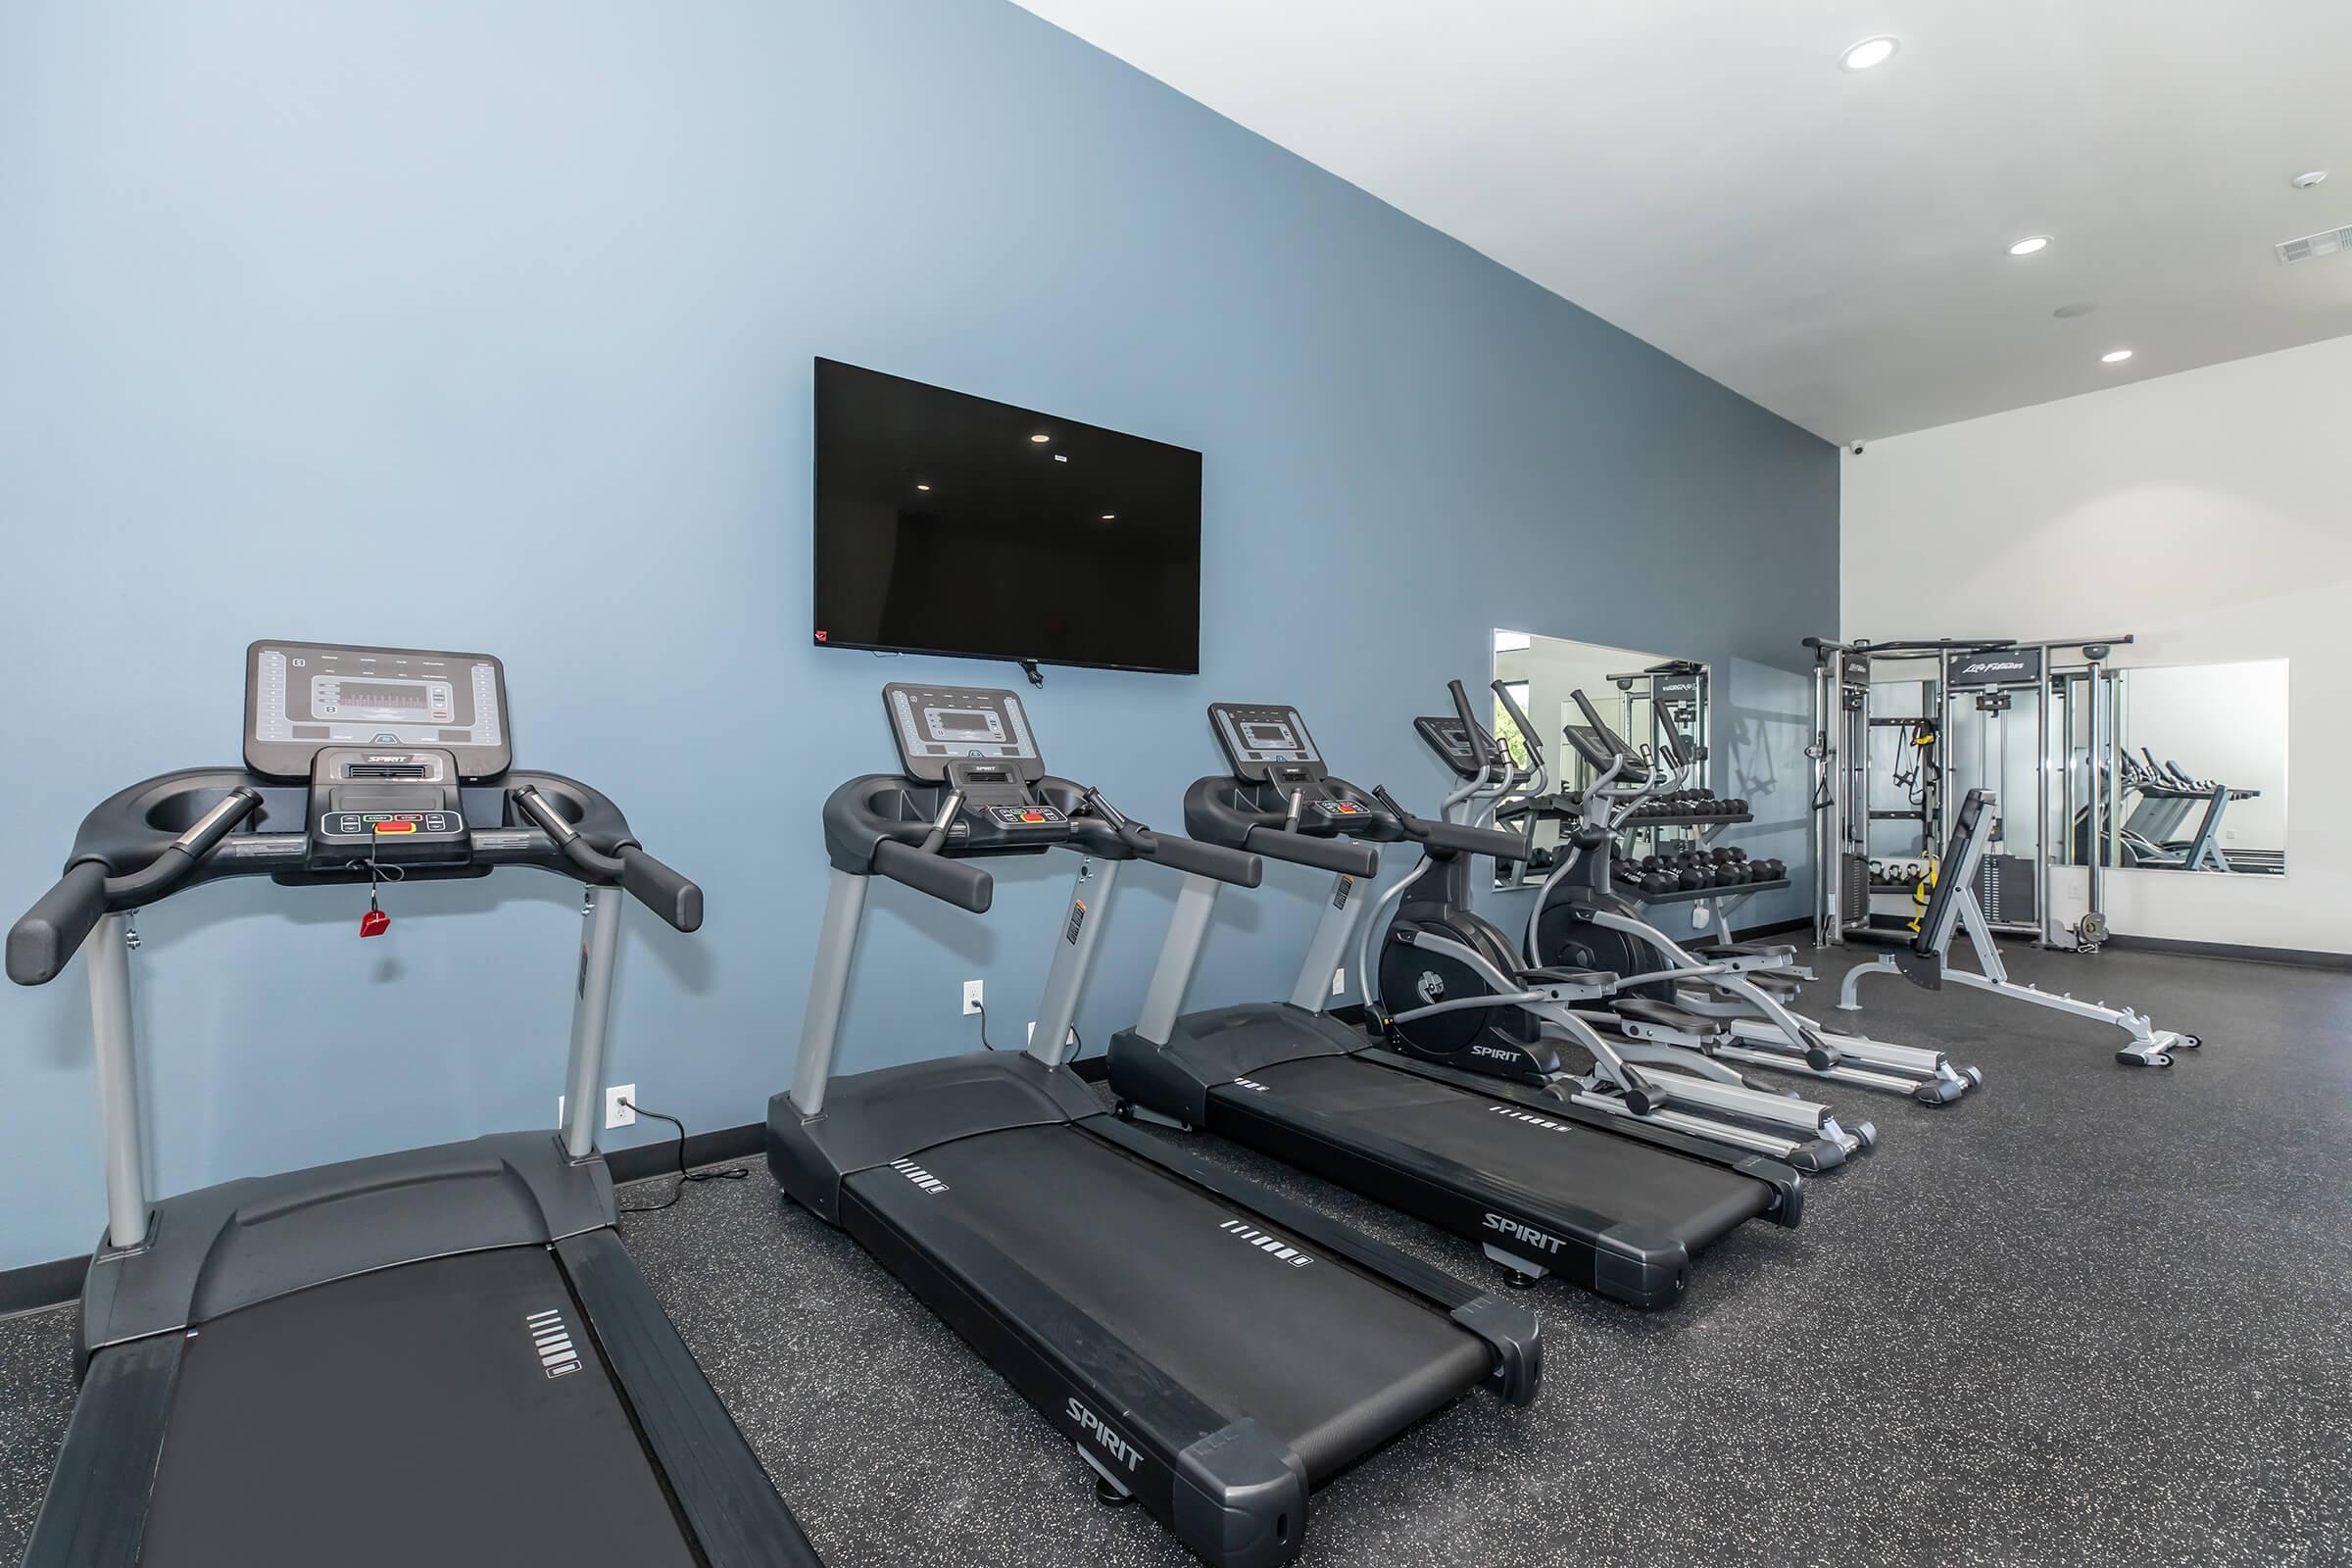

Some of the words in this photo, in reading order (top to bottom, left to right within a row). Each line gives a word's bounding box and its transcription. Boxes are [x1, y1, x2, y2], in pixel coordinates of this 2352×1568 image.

[1471, 1045, 1521, 1062] SPIRIT
[1482, 1213, 1567, 1254] SPIRIT
[1065, 1396, 1145, 1472] SPIRIT
